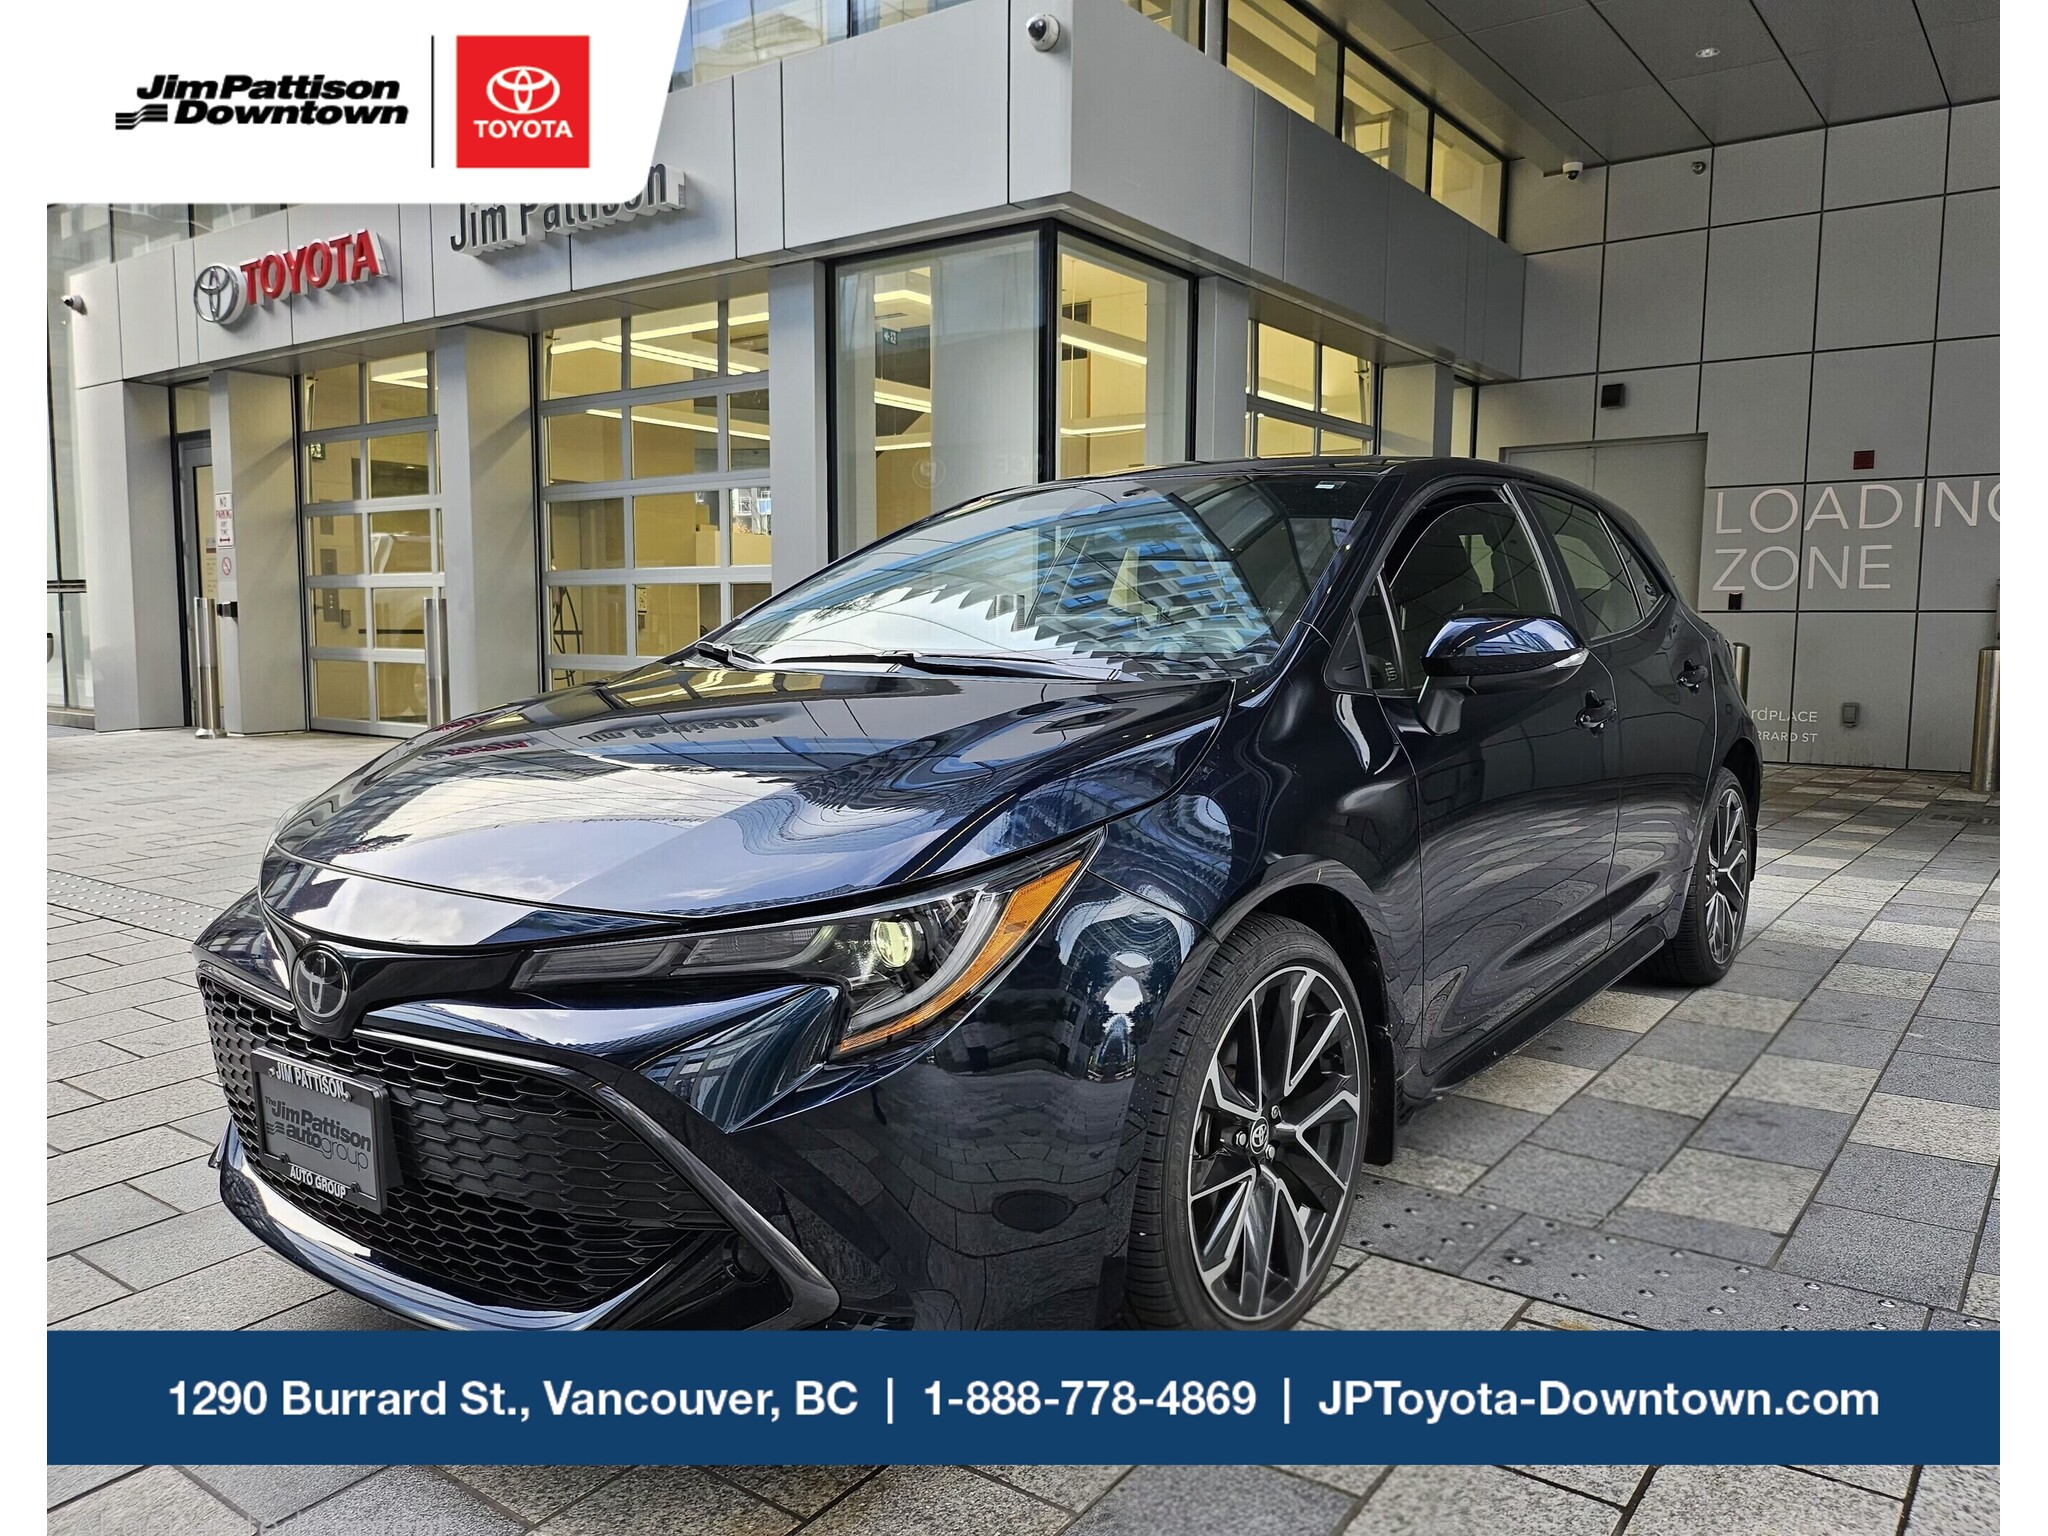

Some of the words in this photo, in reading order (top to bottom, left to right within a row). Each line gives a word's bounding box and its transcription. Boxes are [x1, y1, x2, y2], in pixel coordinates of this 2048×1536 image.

[239, 229, 384, 306] TOYOTA
[1715, 480, 1999, 534] LOADIN
[1711, 544, 1893, 591] ZONE
[1750, 707, 1818, 722] rdPLACE
[1801, 732, 1819, 743] ST
[275, 1062, 294, 1084] JIM
[294, 1067, 346, 1100] PATTISON
[290, 1165, 313, 1185] AUTO
[315, 1174, 347, 1199] GROUP
